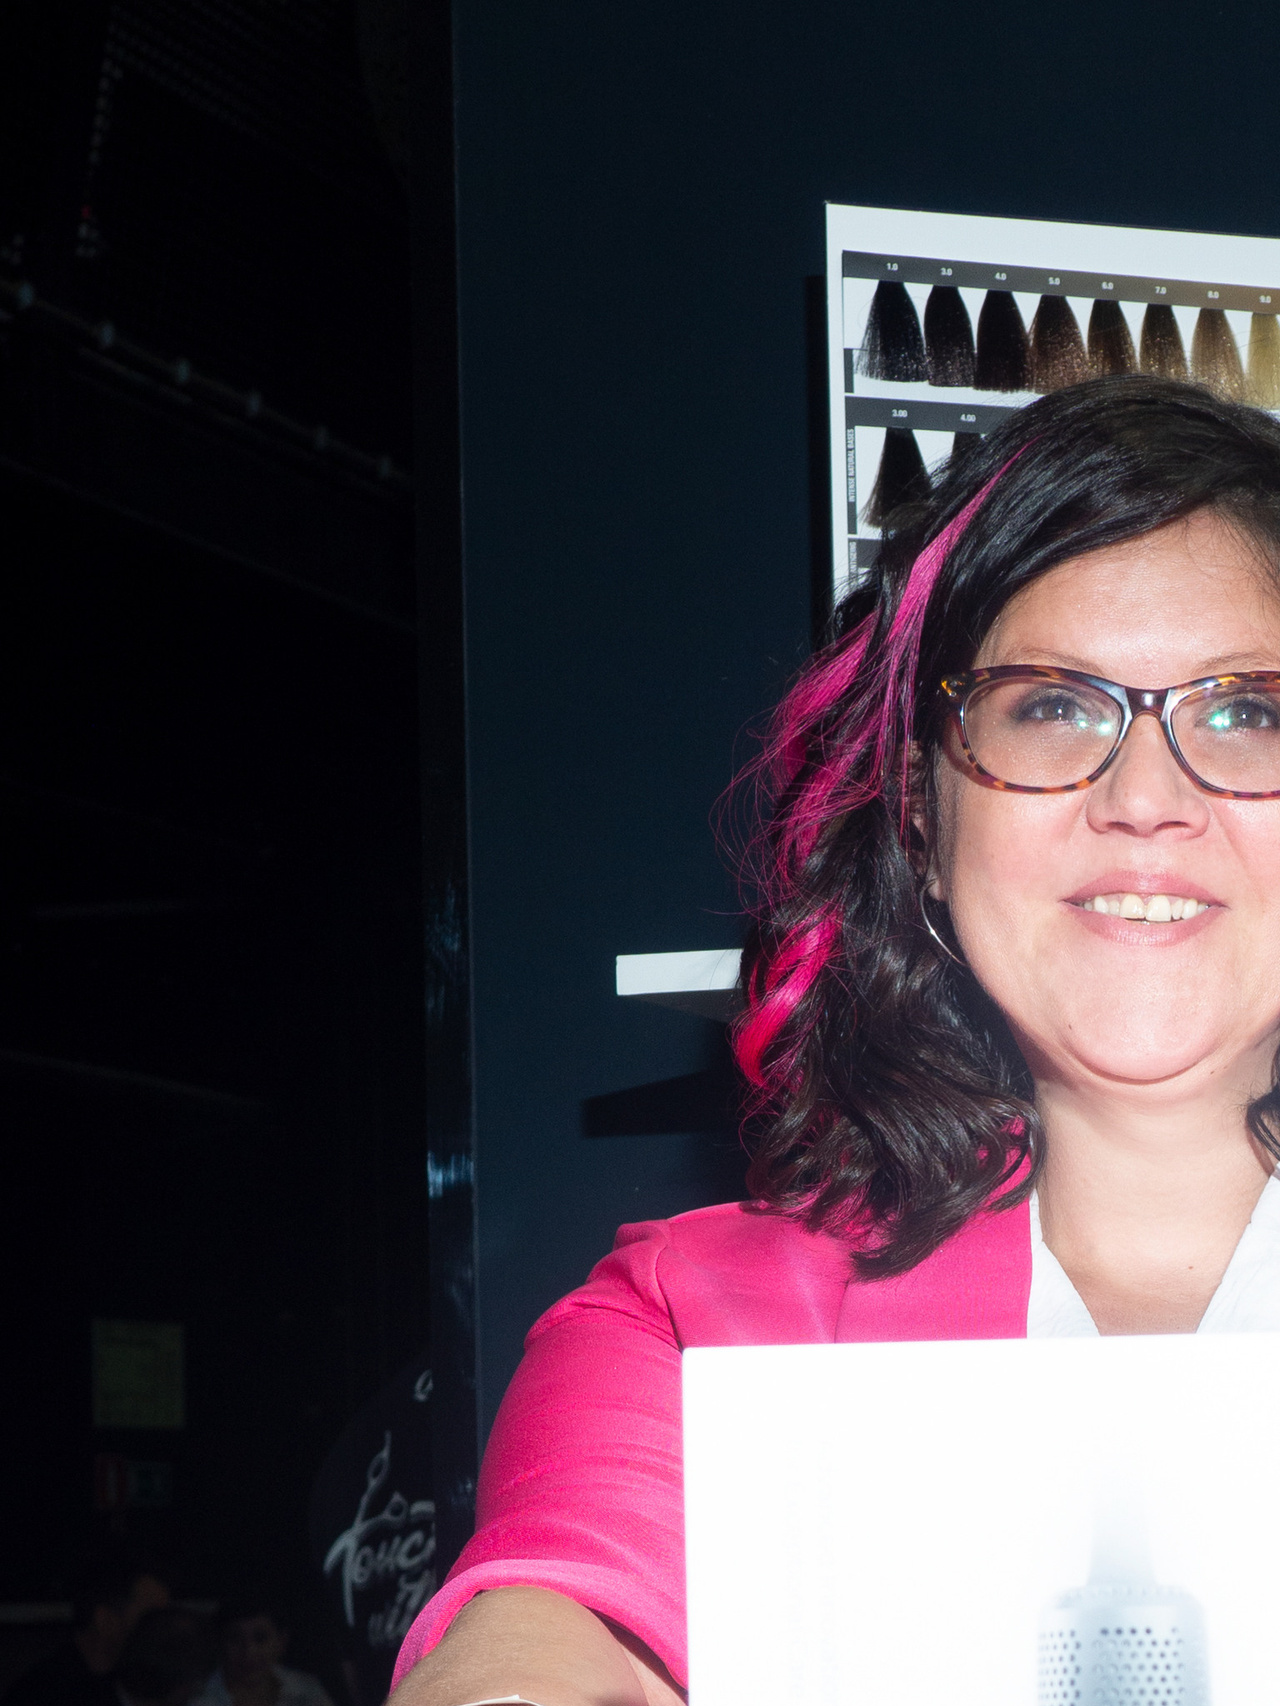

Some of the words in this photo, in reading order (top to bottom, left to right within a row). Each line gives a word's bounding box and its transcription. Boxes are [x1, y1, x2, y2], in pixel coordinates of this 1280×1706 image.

[886, 262, 899, 272] 1.0
[940, 267, 953, 276] 3.0
[995, 272, 1007, 281] 4.0
[1048, 277, 1060, 286] 5.0
[1155, 286, 1167, 295] 7.0
[960, 414, 976, 423] 4.00
